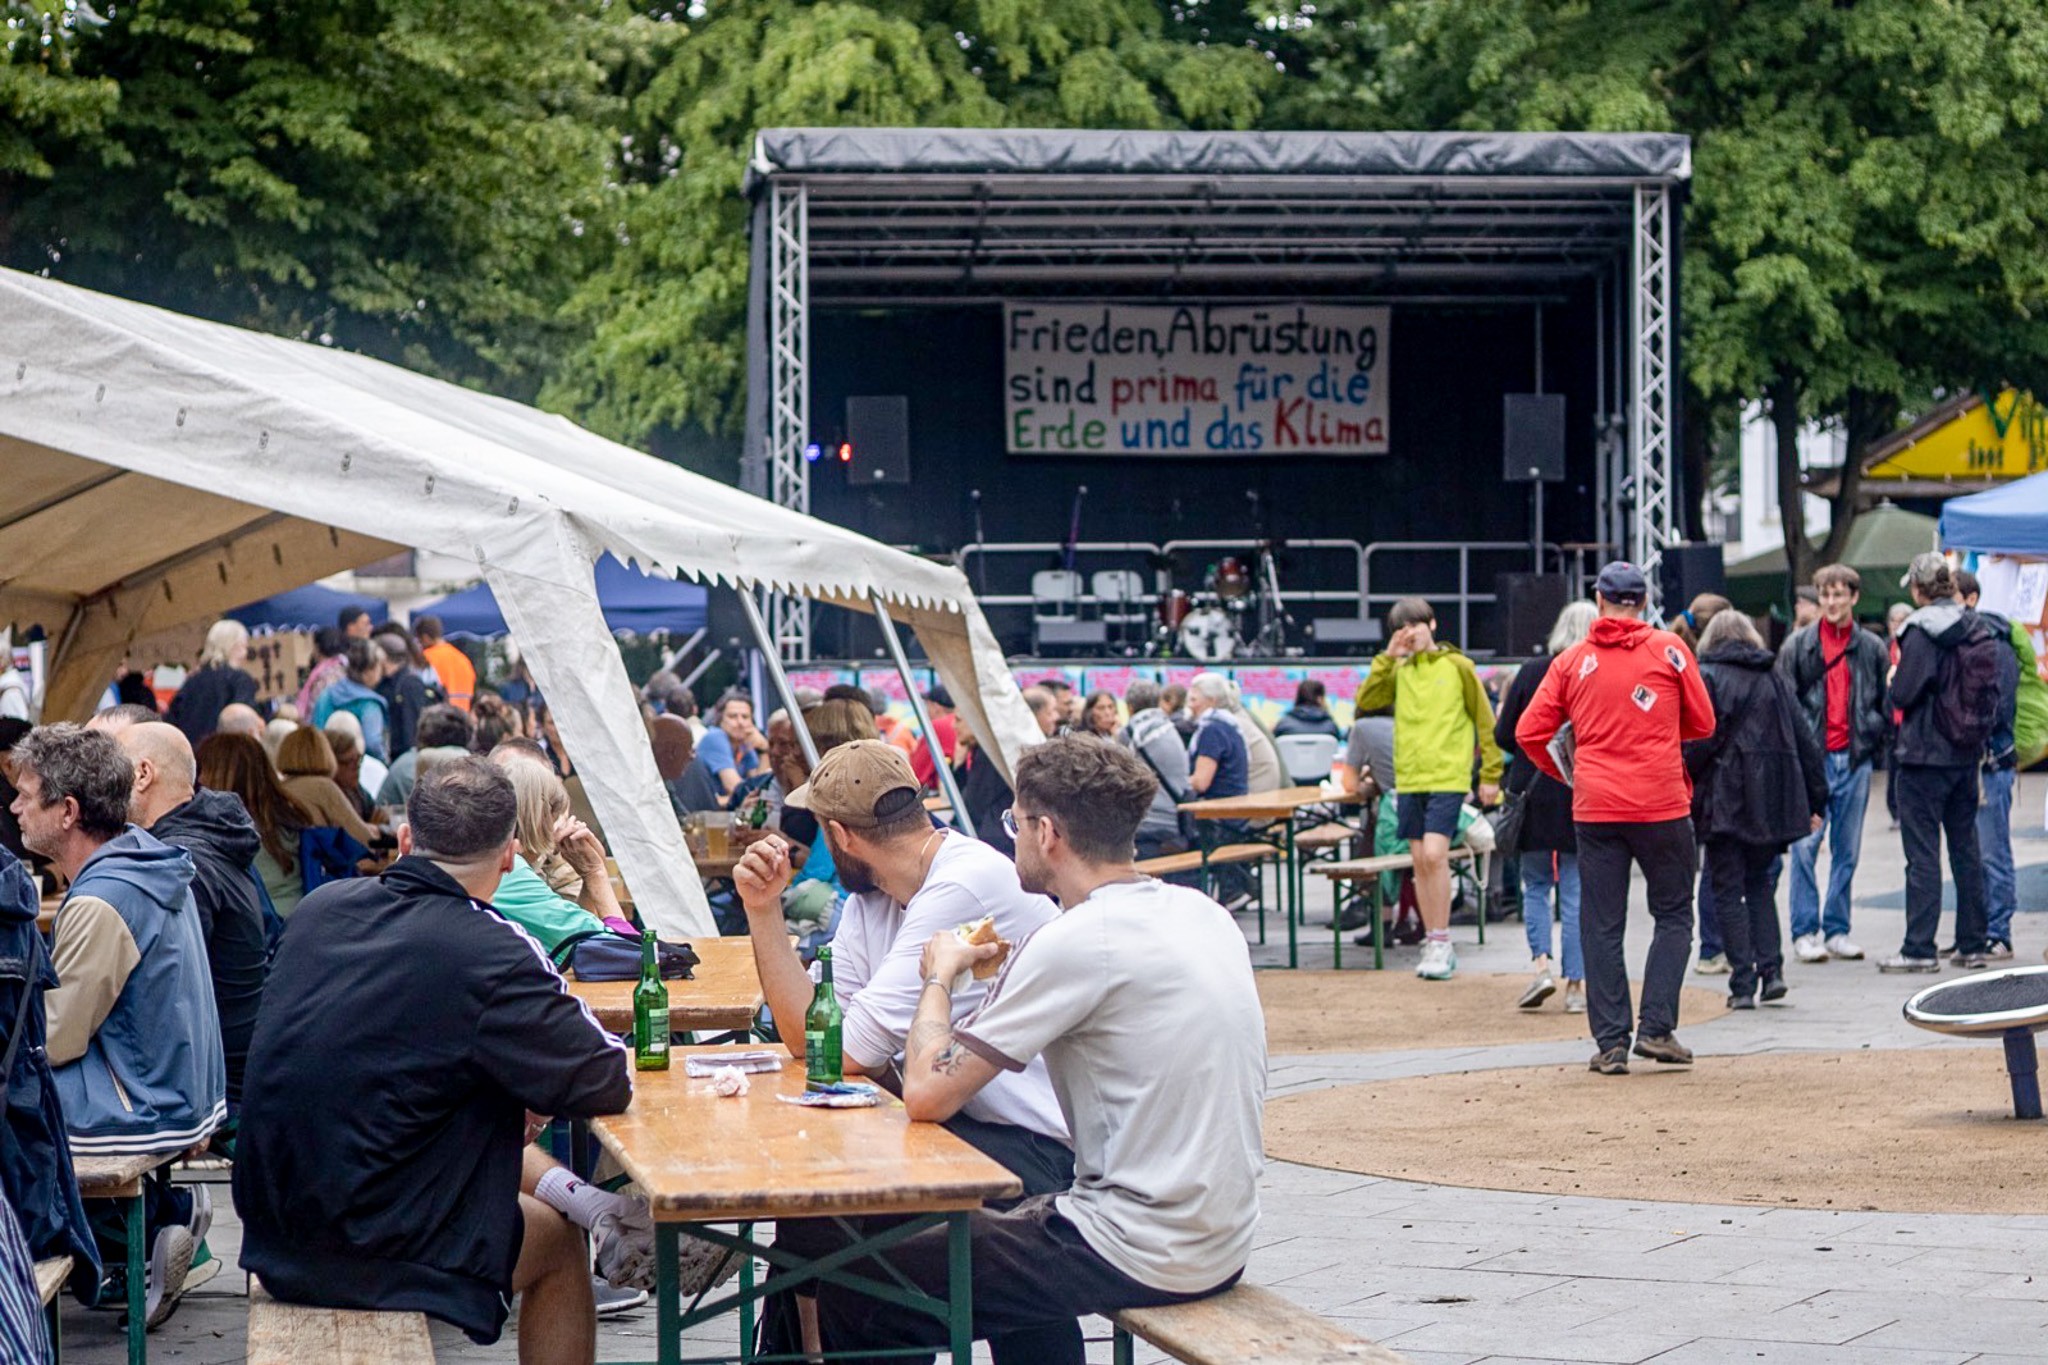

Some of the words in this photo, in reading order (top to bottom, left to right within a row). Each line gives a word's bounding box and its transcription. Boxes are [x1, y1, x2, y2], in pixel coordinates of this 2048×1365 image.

[1009, 360, 1097, 404] sind
[1111, 368, 1219, 415] prima
[1234, 362, 1295, 412] für
[1306, 360, 1370, 405] die
[1012, 409, 1107, 449] Erde
[1121, 408, 1191, 449] und
[1205, 405, 1263, 450] das
[1274, 398, 1385, 446] Klima
